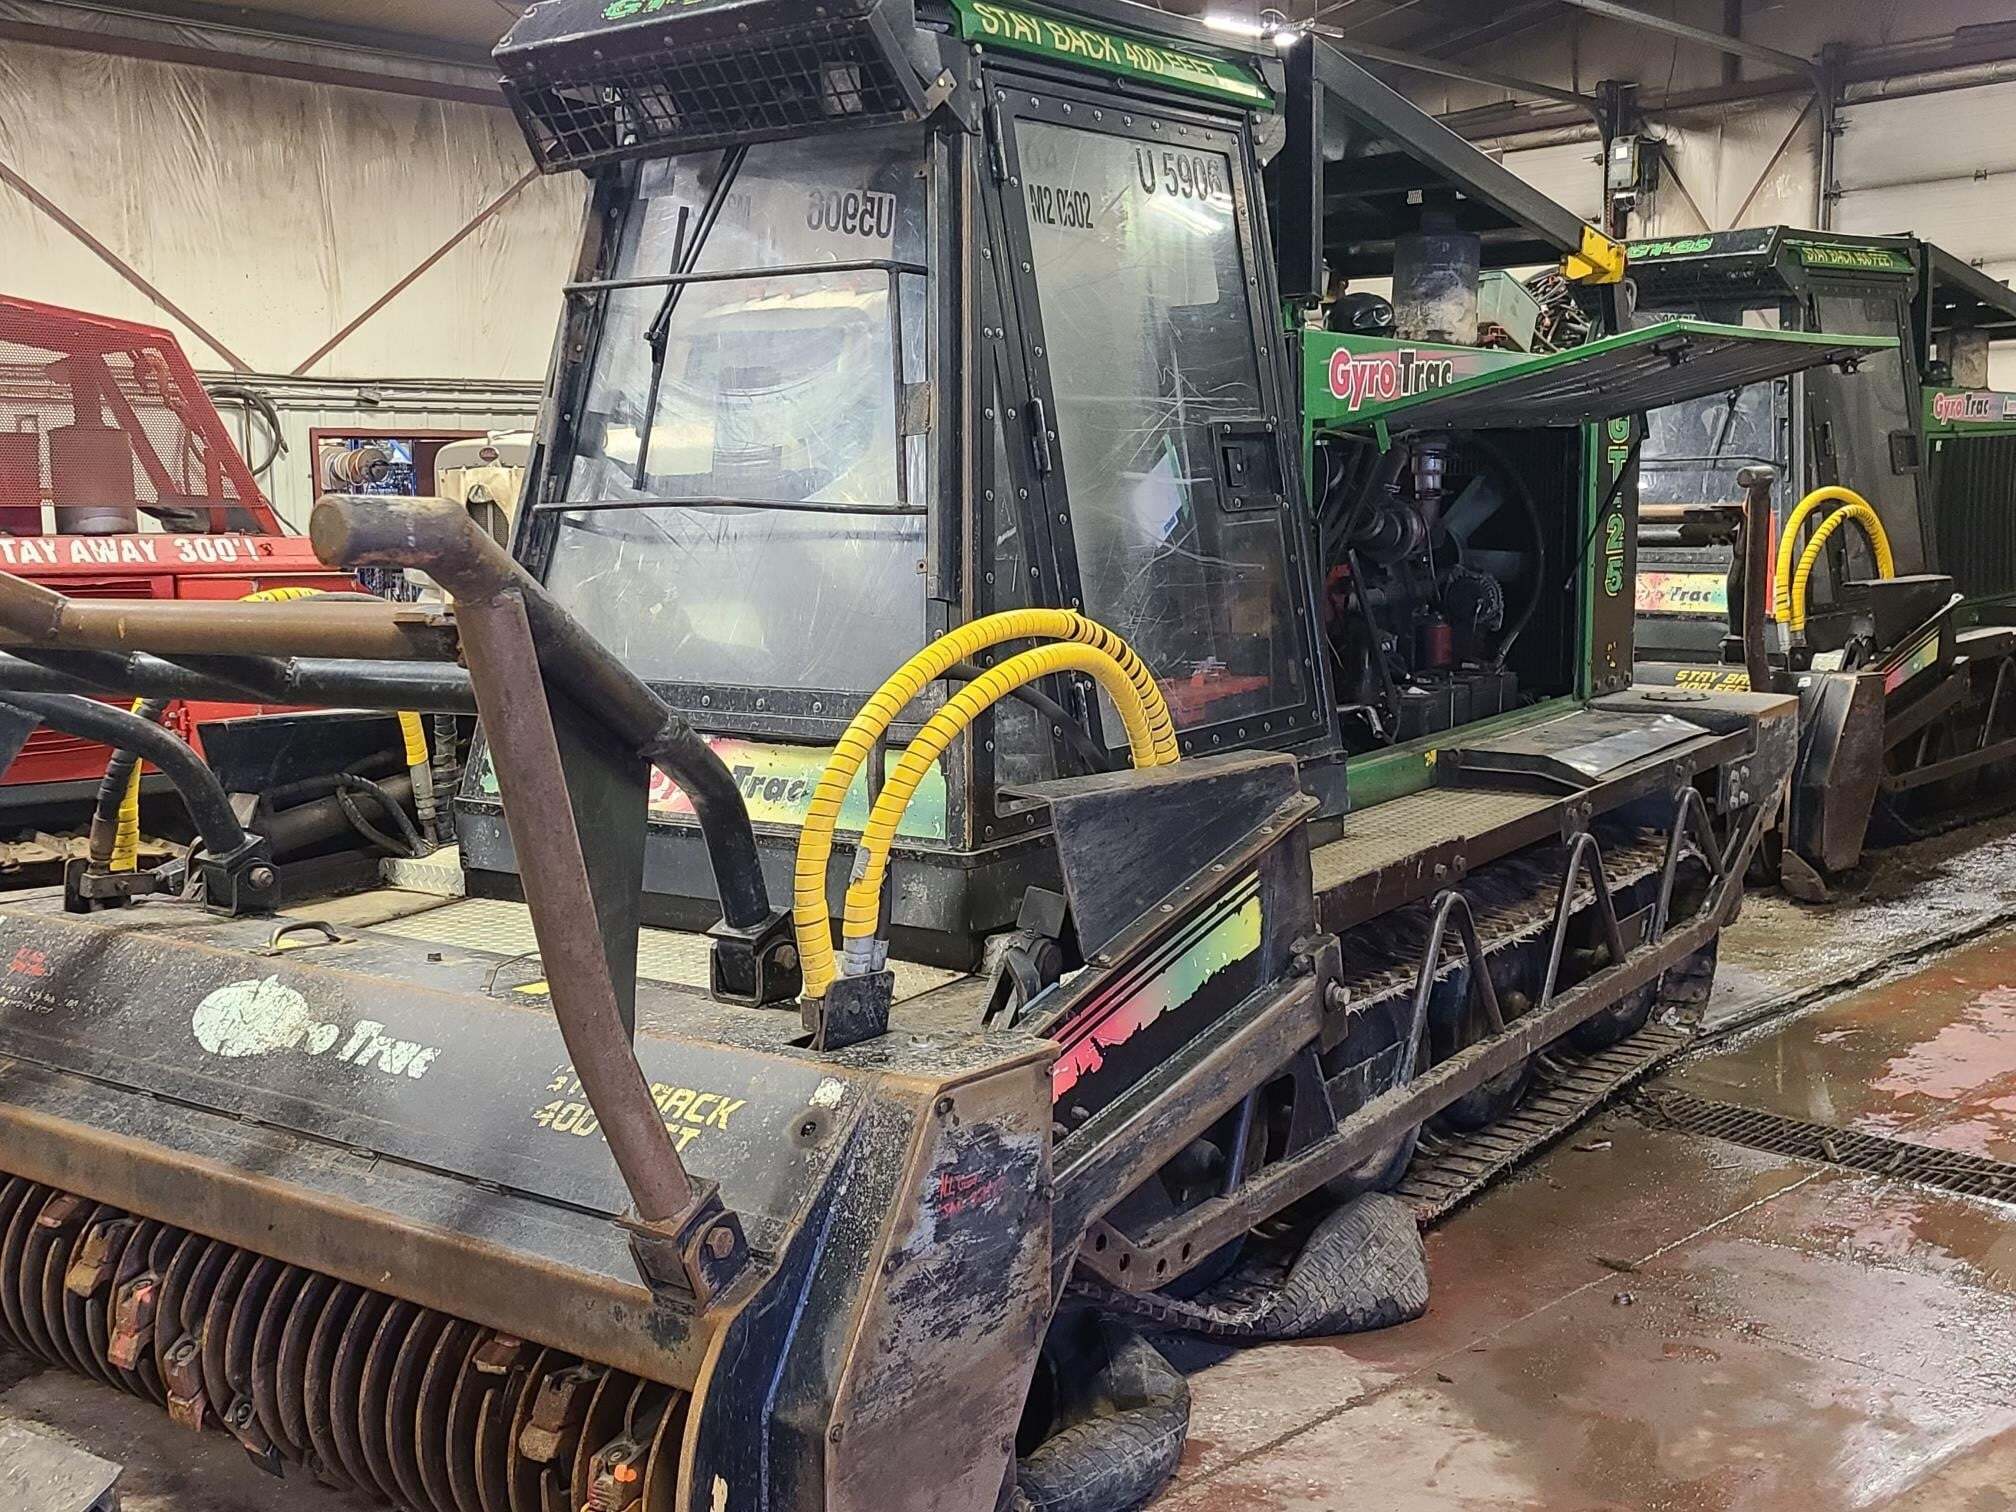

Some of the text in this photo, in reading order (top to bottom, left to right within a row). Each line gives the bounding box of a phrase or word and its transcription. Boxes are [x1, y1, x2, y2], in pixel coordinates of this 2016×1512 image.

[973, 2, 1219, 80] STAY BACK 400 FEET
[1136, 145, 1157, 195] U
[1028, 184, 1056, 225] M2
[0, 538, 58, 564] TAY
[70, 538, 158, 564] AWAY
[1675, 670, 1751, 686] STAY BA
[732, 764, 808, 803] Trac
[531, 1099, 600, 1137] 400
